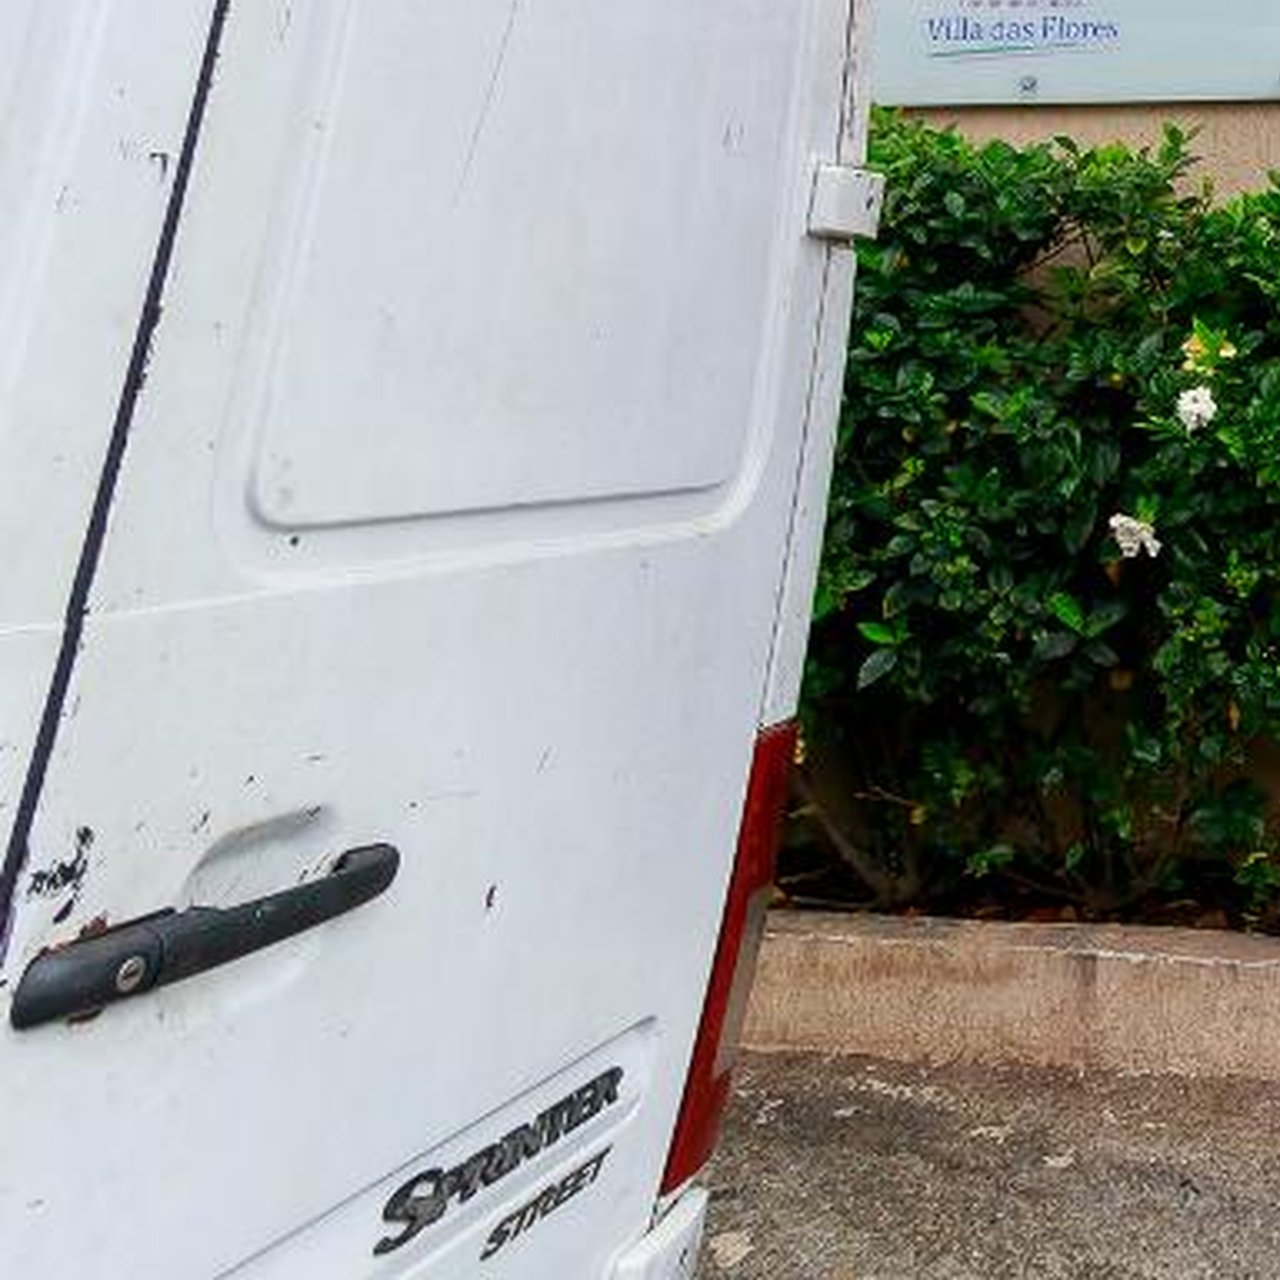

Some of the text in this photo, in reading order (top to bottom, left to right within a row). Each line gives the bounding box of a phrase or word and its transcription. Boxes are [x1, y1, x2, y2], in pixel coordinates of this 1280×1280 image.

[928, 14, 1119, 41] Villa das Flores
[479, 1142, 614, 1261] STREET
